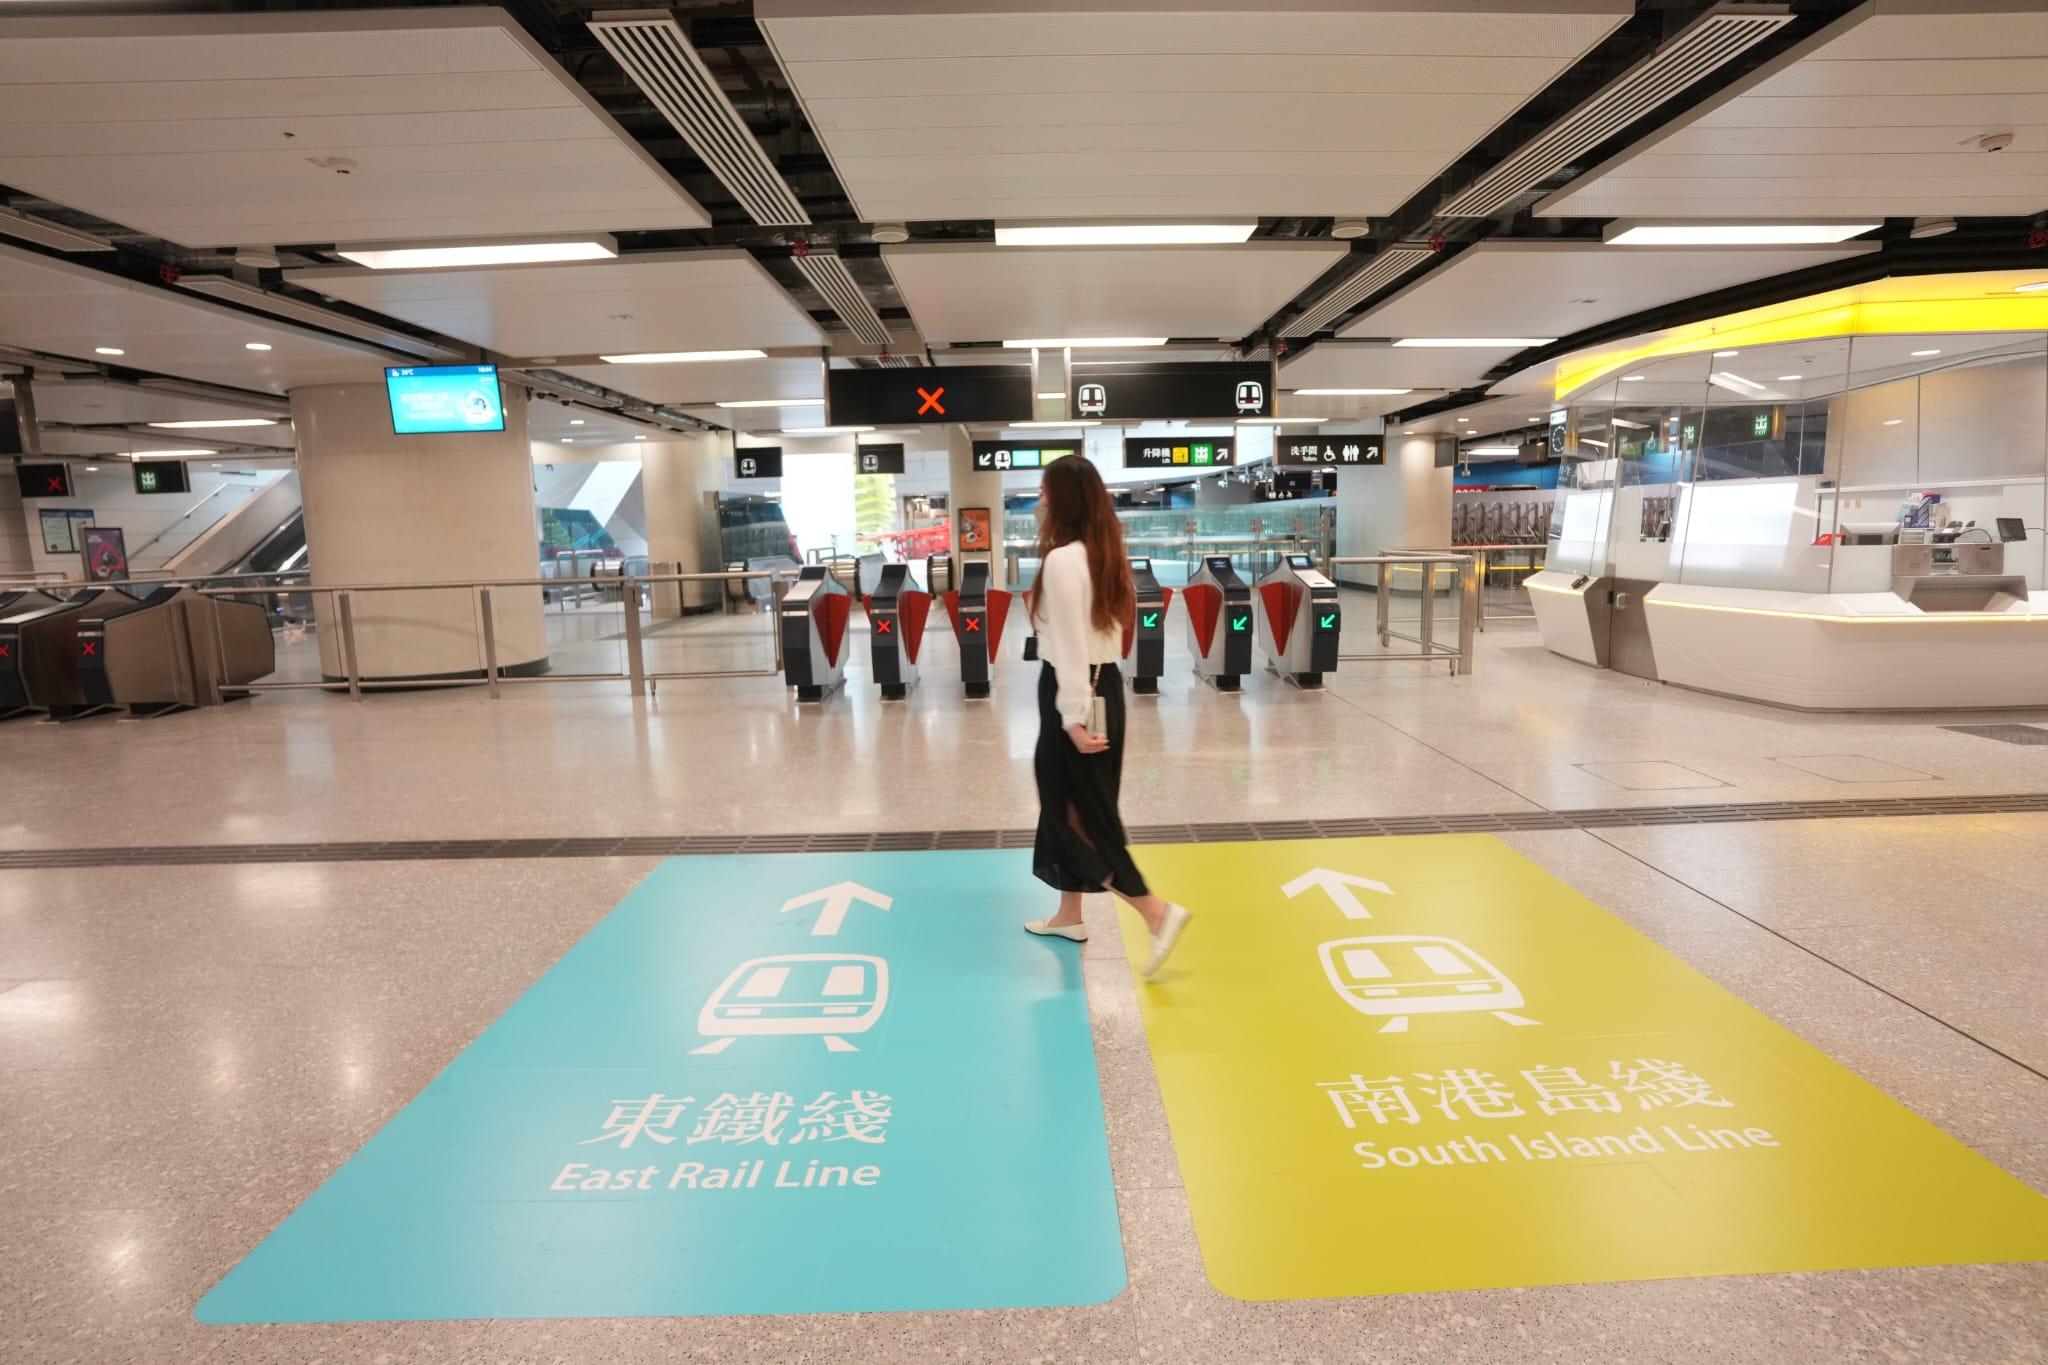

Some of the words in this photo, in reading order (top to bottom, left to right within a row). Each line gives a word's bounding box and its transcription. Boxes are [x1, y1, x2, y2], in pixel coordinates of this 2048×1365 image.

[1756, 414, 1768, 430] 出
[1290, 445, 1318, 456] 洗手間
[1315, 1058, 1735, 1130] 南港島綫
[577, 1090, 893, 1149] 東鐵綫
[1353, 1136, 1508, 1169] South
[1507, 1126, 1665, 1161] Island
[1662, 1124, 1781, 1152] Line
[550, 1163, 660, 1191] East
[667, 1159, 765, 1190] Rail
[773, 1159, 882, 1188] Line
